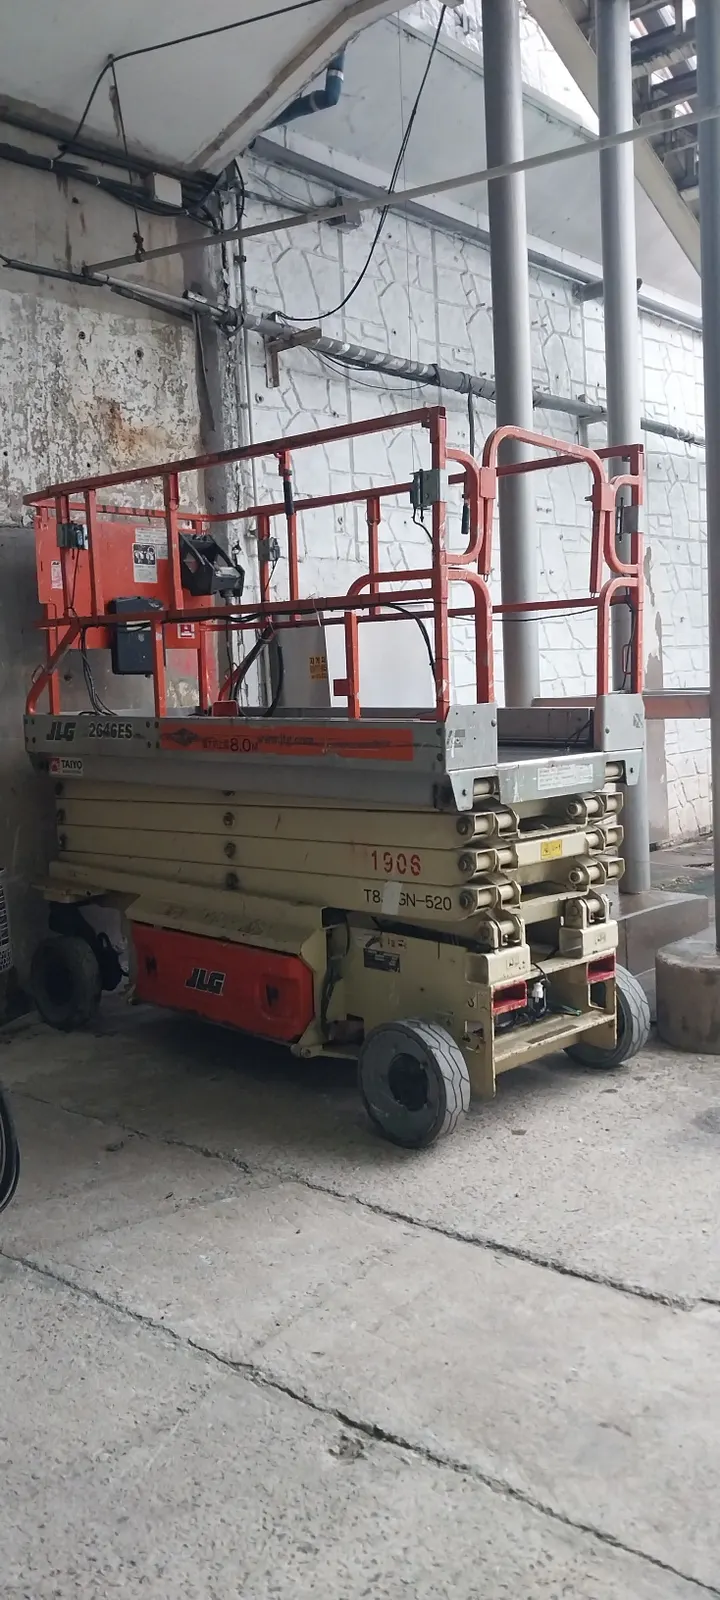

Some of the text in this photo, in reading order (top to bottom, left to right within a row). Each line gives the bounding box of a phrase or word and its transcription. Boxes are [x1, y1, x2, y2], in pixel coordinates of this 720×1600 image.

[46, 721, 77, 741] JLG
[61, 760, 83, 769] TAIYO
[184, 967, 226, 996] JLG
